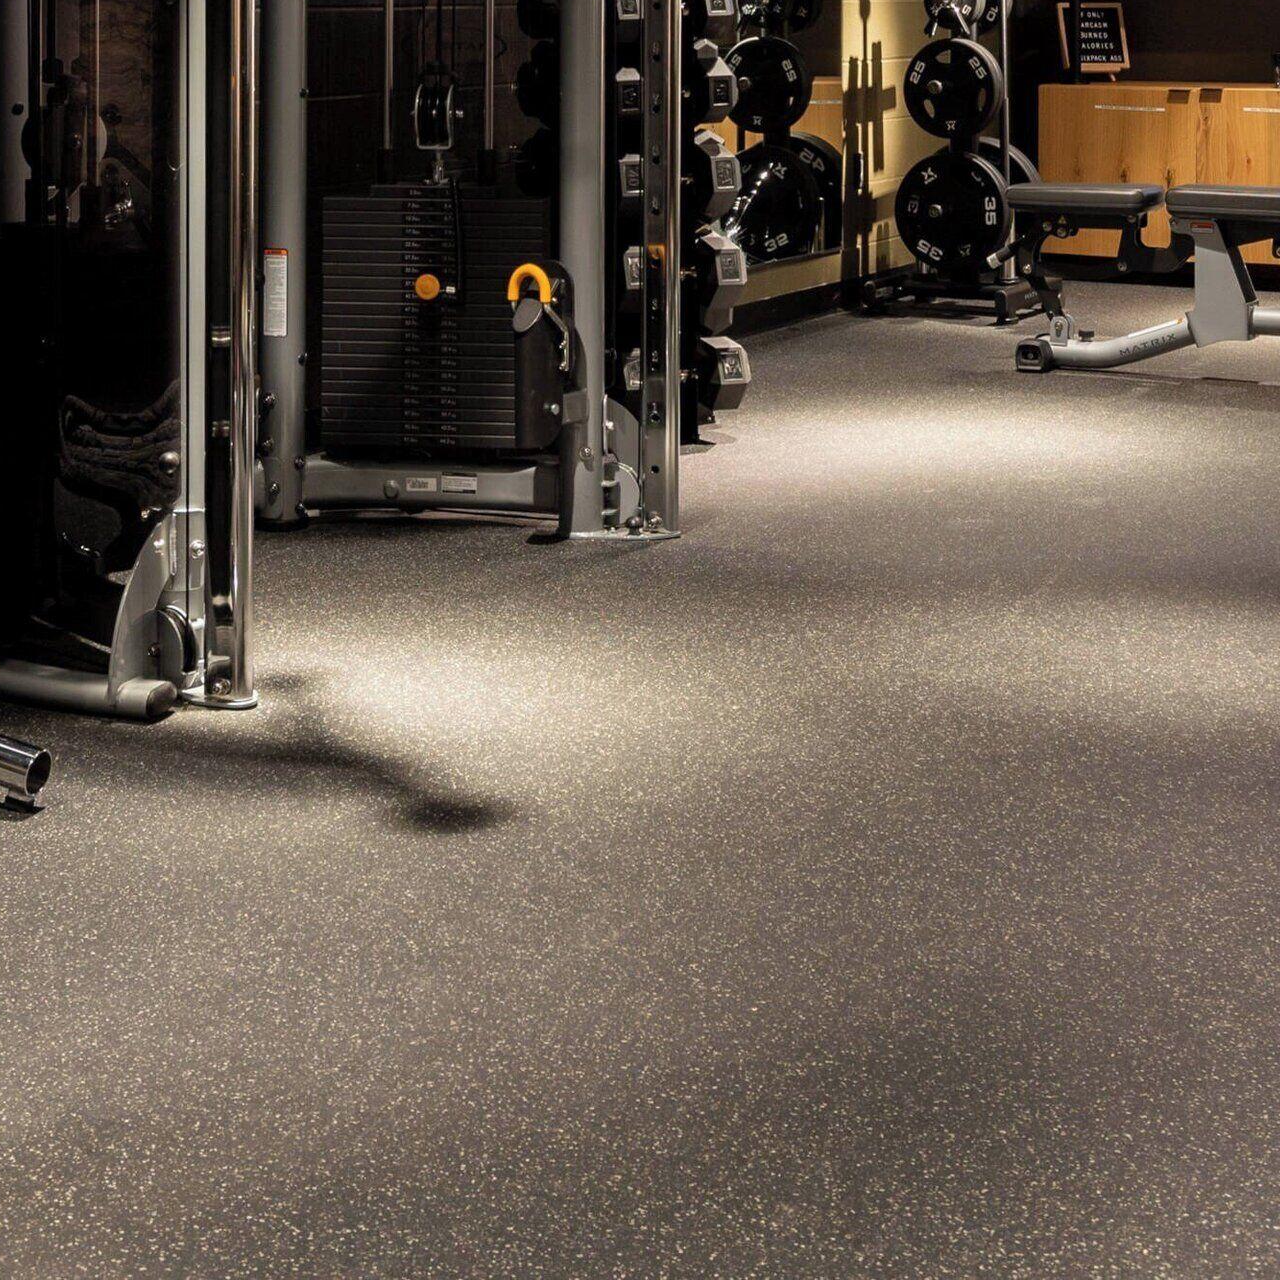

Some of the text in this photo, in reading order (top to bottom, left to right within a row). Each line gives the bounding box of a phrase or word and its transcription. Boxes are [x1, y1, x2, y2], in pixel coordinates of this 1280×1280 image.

[961, 4, 972, 16] 5
[985, 6, 998, 22] 10
[1081, 42, 1114, 50] ALORIES
[968, 56, 987, 80] 25
[1110, 54, 1122, 62] ASS
[909, 60, 926, 85] 25
[984, 196, 997, 226] 35
[916, 238, 944, 261] 35
[1119, 333, 1177, 357] MATRIX
